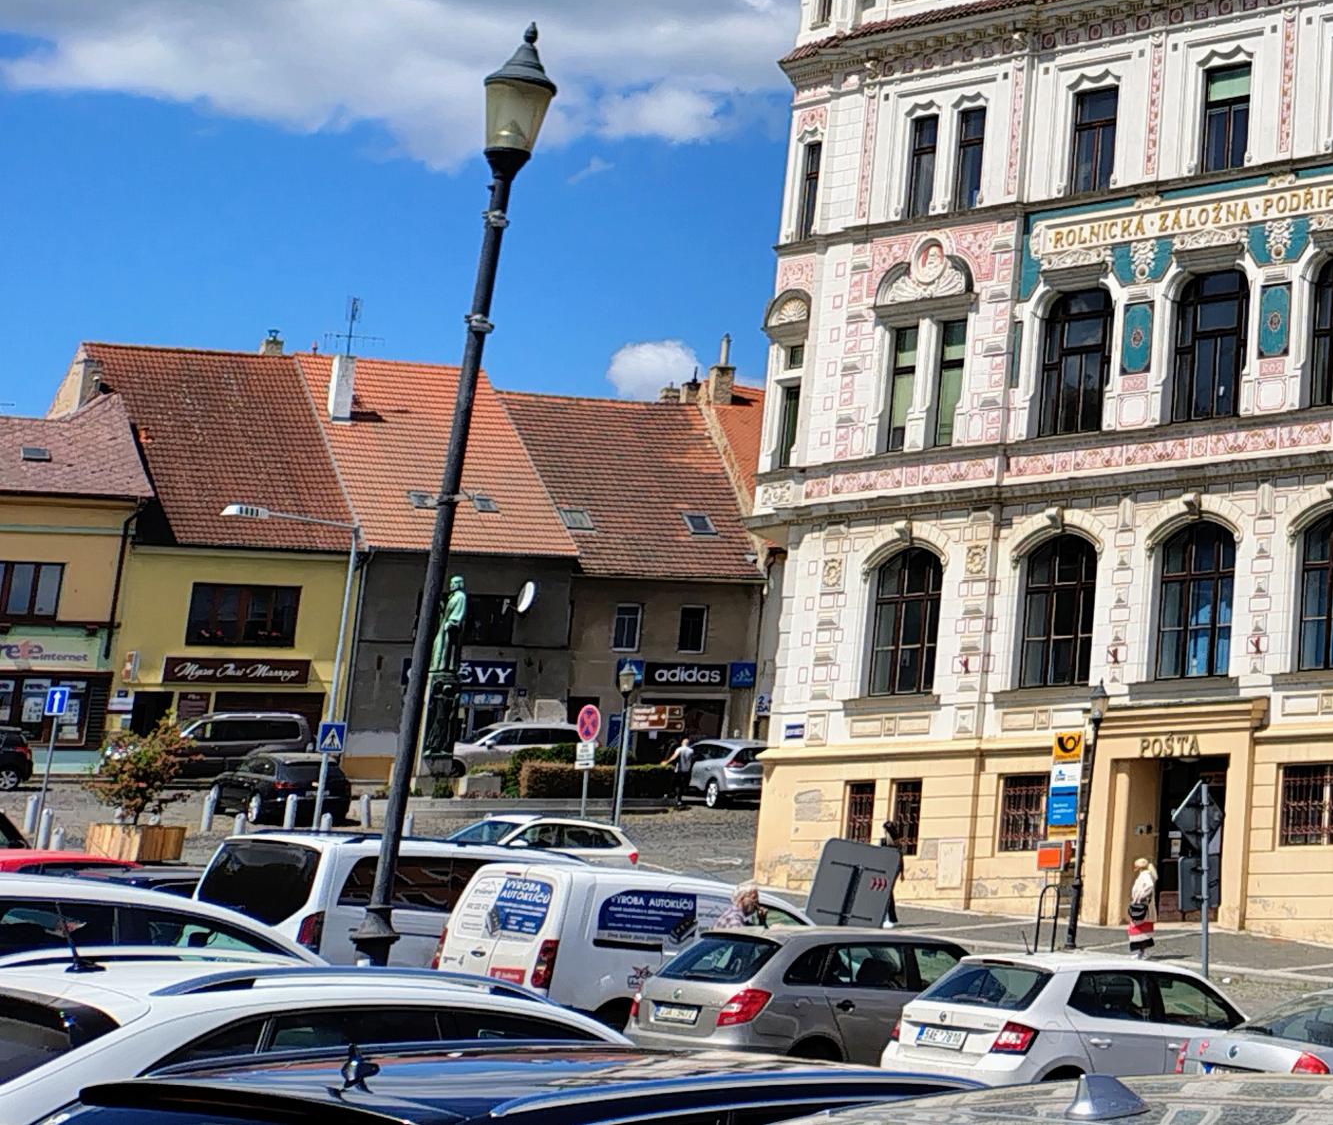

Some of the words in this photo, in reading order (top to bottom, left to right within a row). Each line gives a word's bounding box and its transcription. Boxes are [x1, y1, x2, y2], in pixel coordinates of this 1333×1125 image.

[1052, 213, 1146, 249] ROLNICKÁ
[1158, 200, 1251, 236] ZÁLOŽNA
[654, 666, 721, 683] adidas
[1140, 732, 1201, 757] POŠTA
[506, 878, 541, 891] VÝROBA
[611, 895, 645, 906] VÝROBA
